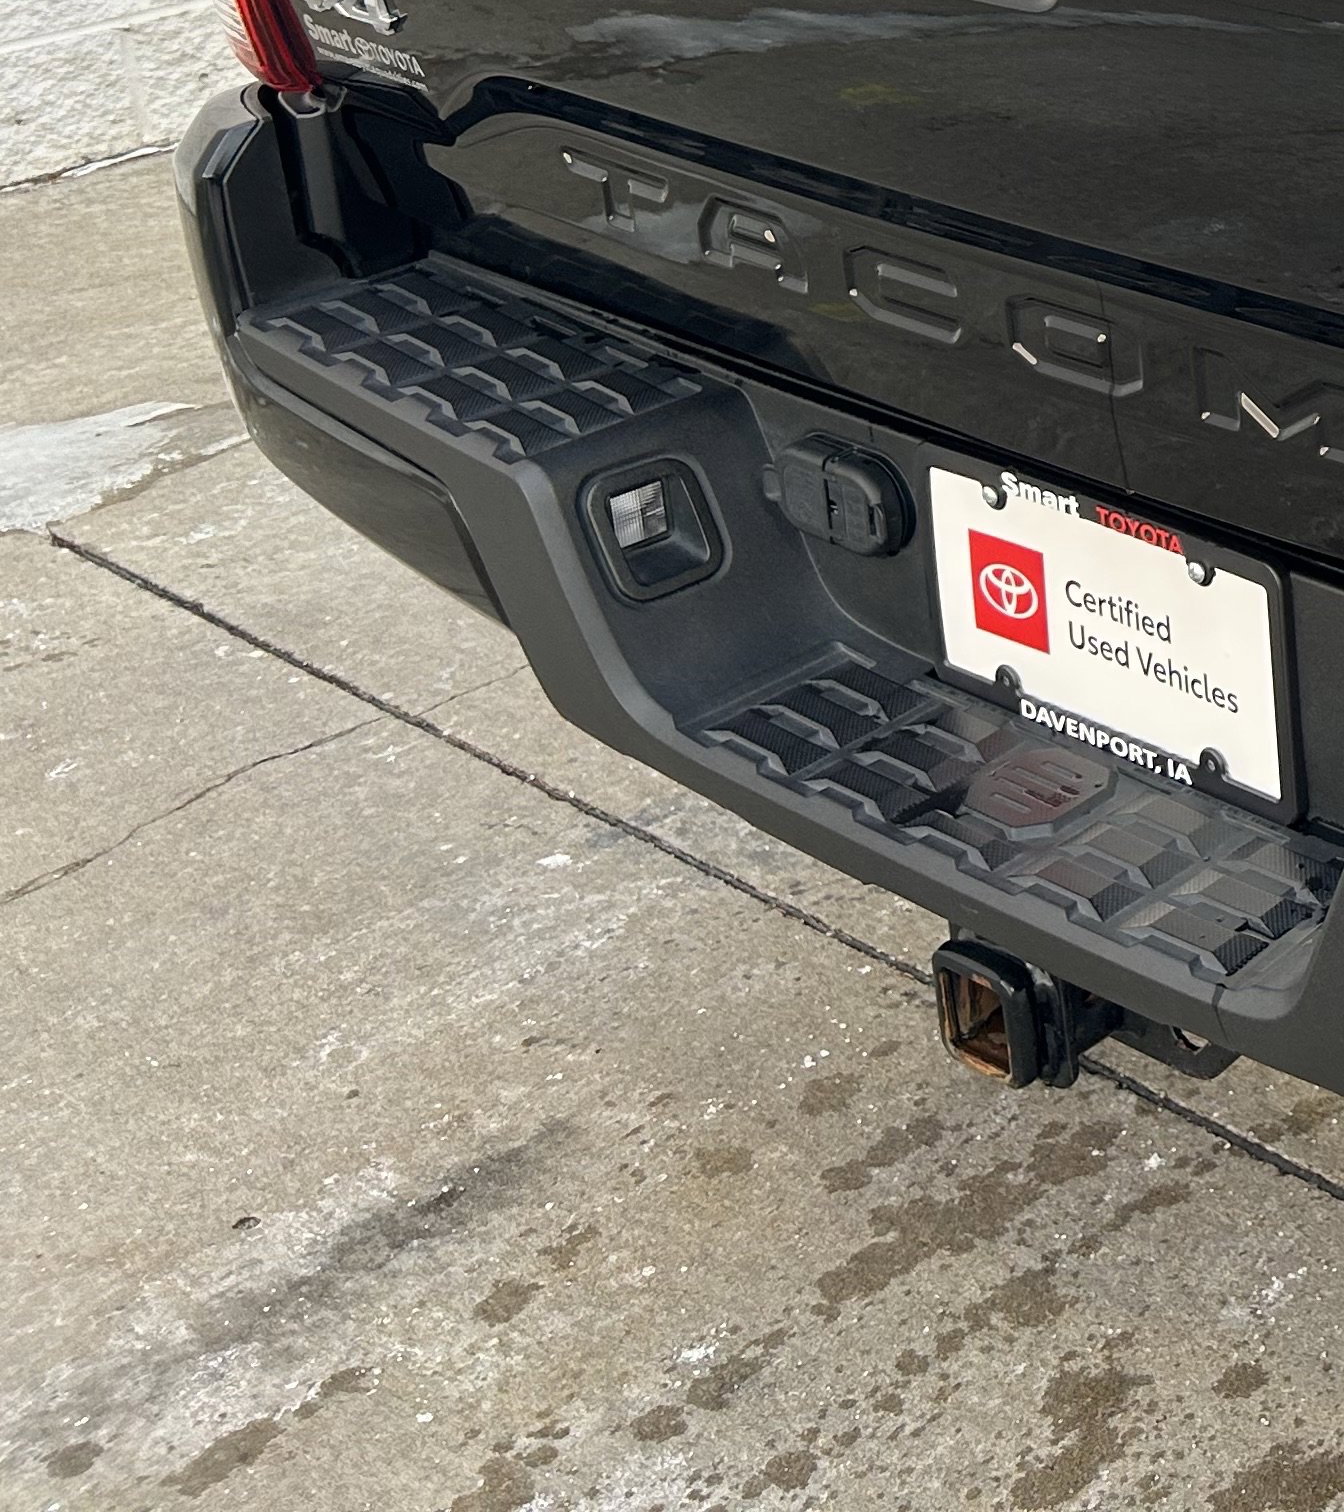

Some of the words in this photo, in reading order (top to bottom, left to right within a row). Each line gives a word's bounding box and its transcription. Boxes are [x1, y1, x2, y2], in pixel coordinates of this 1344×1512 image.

[303, 13, 357, 56] Smart
[373, 41, 426, 78] TOYOTA
[1000, 471, 1080, 518] Smart
[1096, 506, 1184, 555] TOYOTA
[1064, 579, 1173, 645] Certified
[1068, 620, 1130, 669] Used
[1136, 646, 1239, 714] Vehicles
[1020, 698, 1163, 775] DAVENPORT,
[1167, 757, 1193, 786] IA
